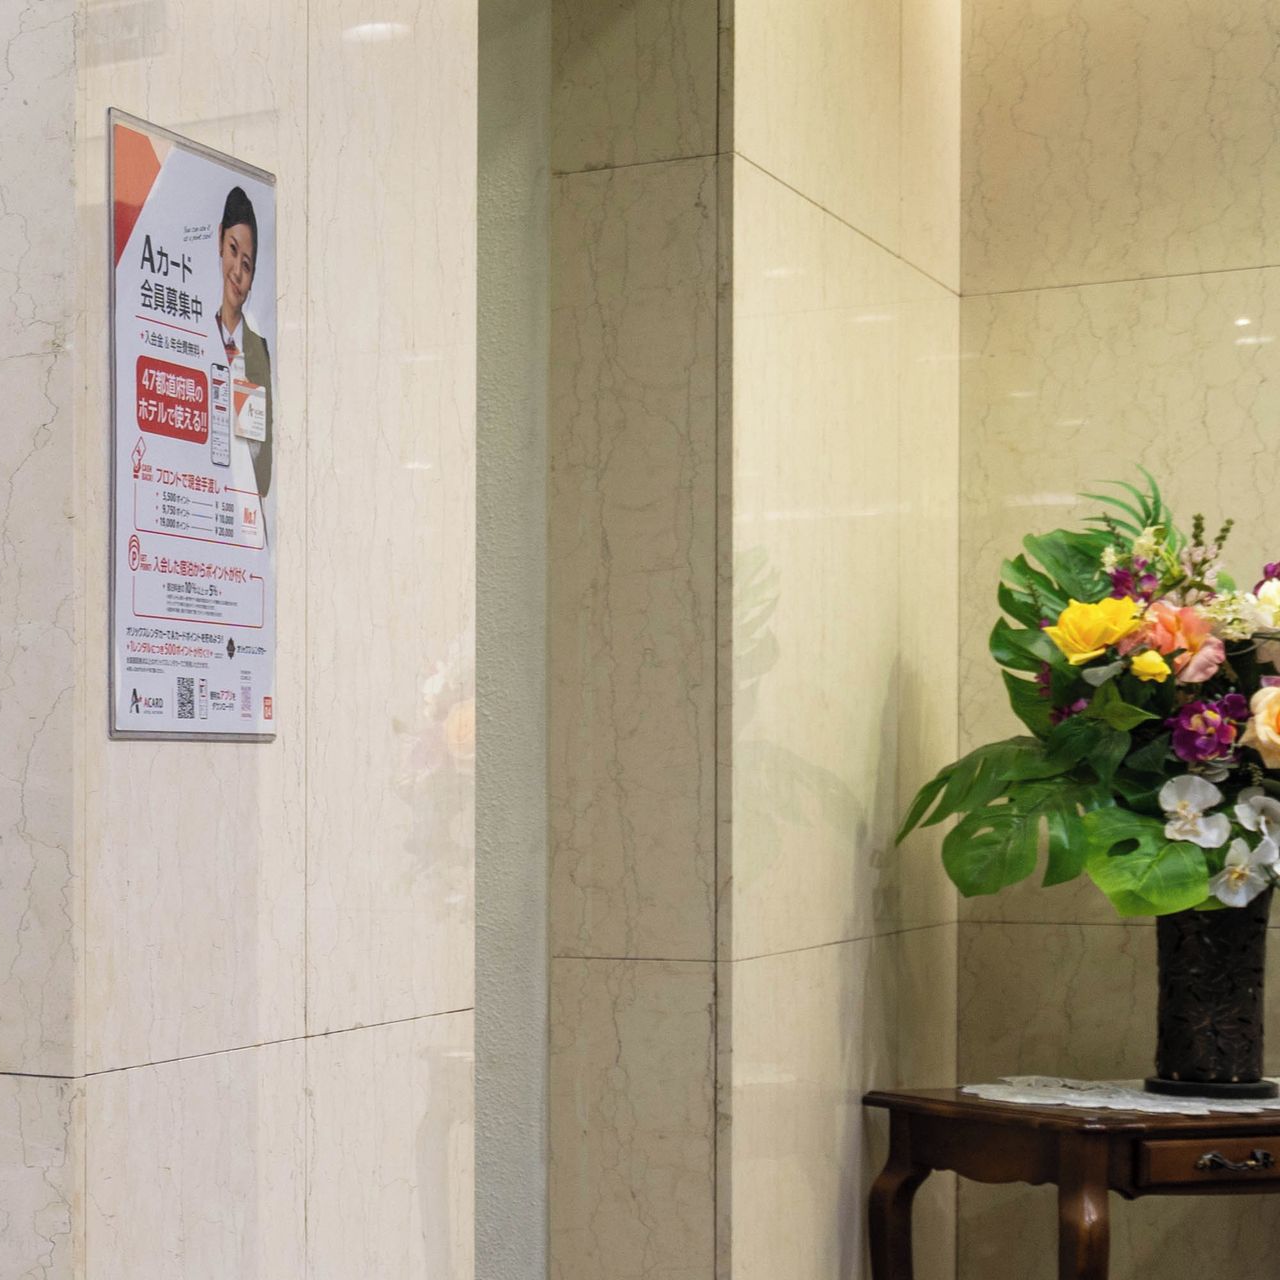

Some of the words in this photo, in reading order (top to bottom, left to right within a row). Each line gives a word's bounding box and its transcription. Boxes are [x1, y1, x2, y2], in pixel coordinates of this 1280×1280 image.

[141, 234, 192, 283] Aカード
[141, 279, 202, 323] 会員募集中
[142, 368, 203, 402] 47都道府県の
[156, 468, 220, 494] フロントで現金手渡し
